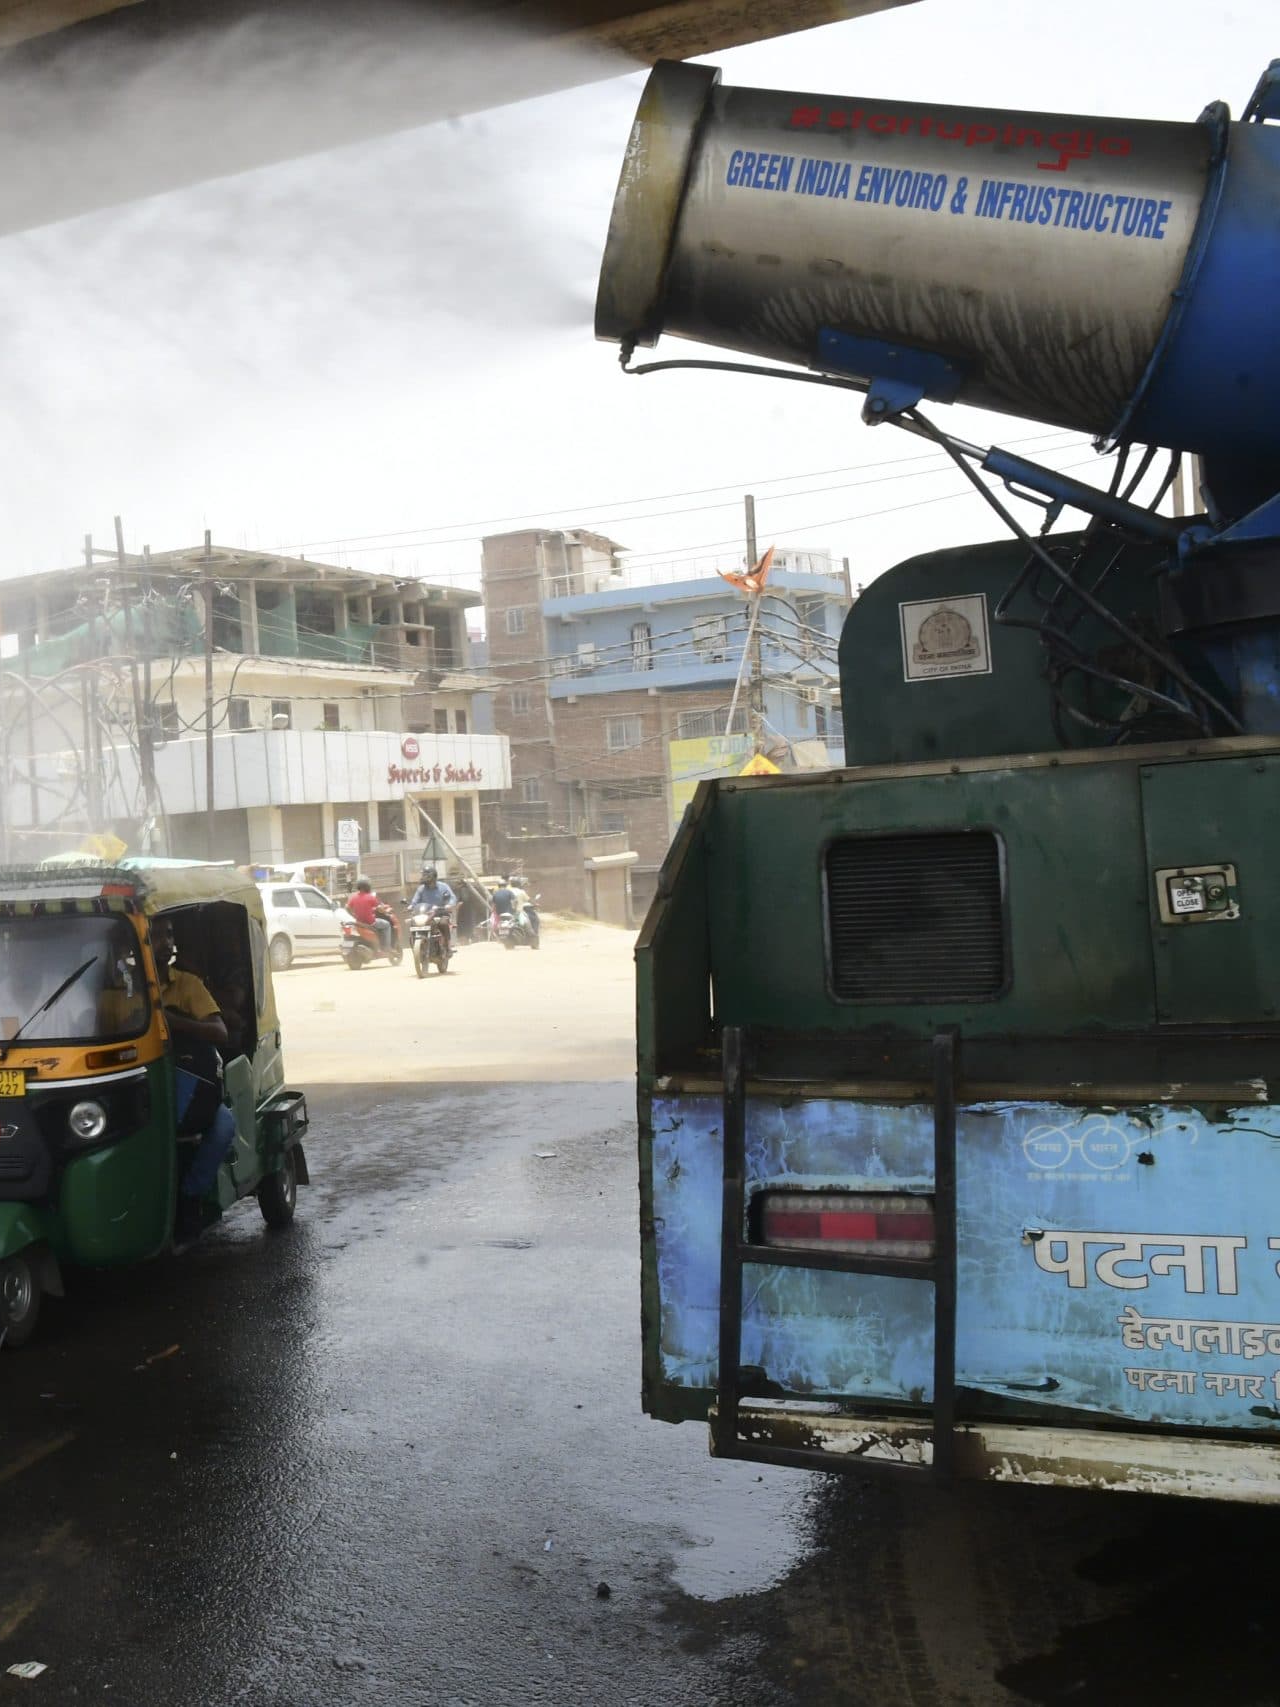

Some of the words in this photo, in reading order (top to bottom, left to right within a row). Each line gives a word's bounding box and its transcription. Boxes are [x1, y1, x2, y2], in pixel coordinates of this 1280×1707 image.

[726, 150, 795, 192] GREEN
[795, 157, 852, 200] INDIA
[854, 164, 948, 213] ENVOIRO
[950, 176, 969, 214] &
[975, 179, 1173, 241] INFRUSTRUCTURE
[923, 666, 938, 674] CITY
[444, 760, 483, 783] Snacks
[1176, 898, 1200, 907] CLOSE
[1024, 1229, 1248, 1295] पटना
[1123, 1367, 1198, 1395] पटना
[1203, 1371, 1266, 1399] नगर
